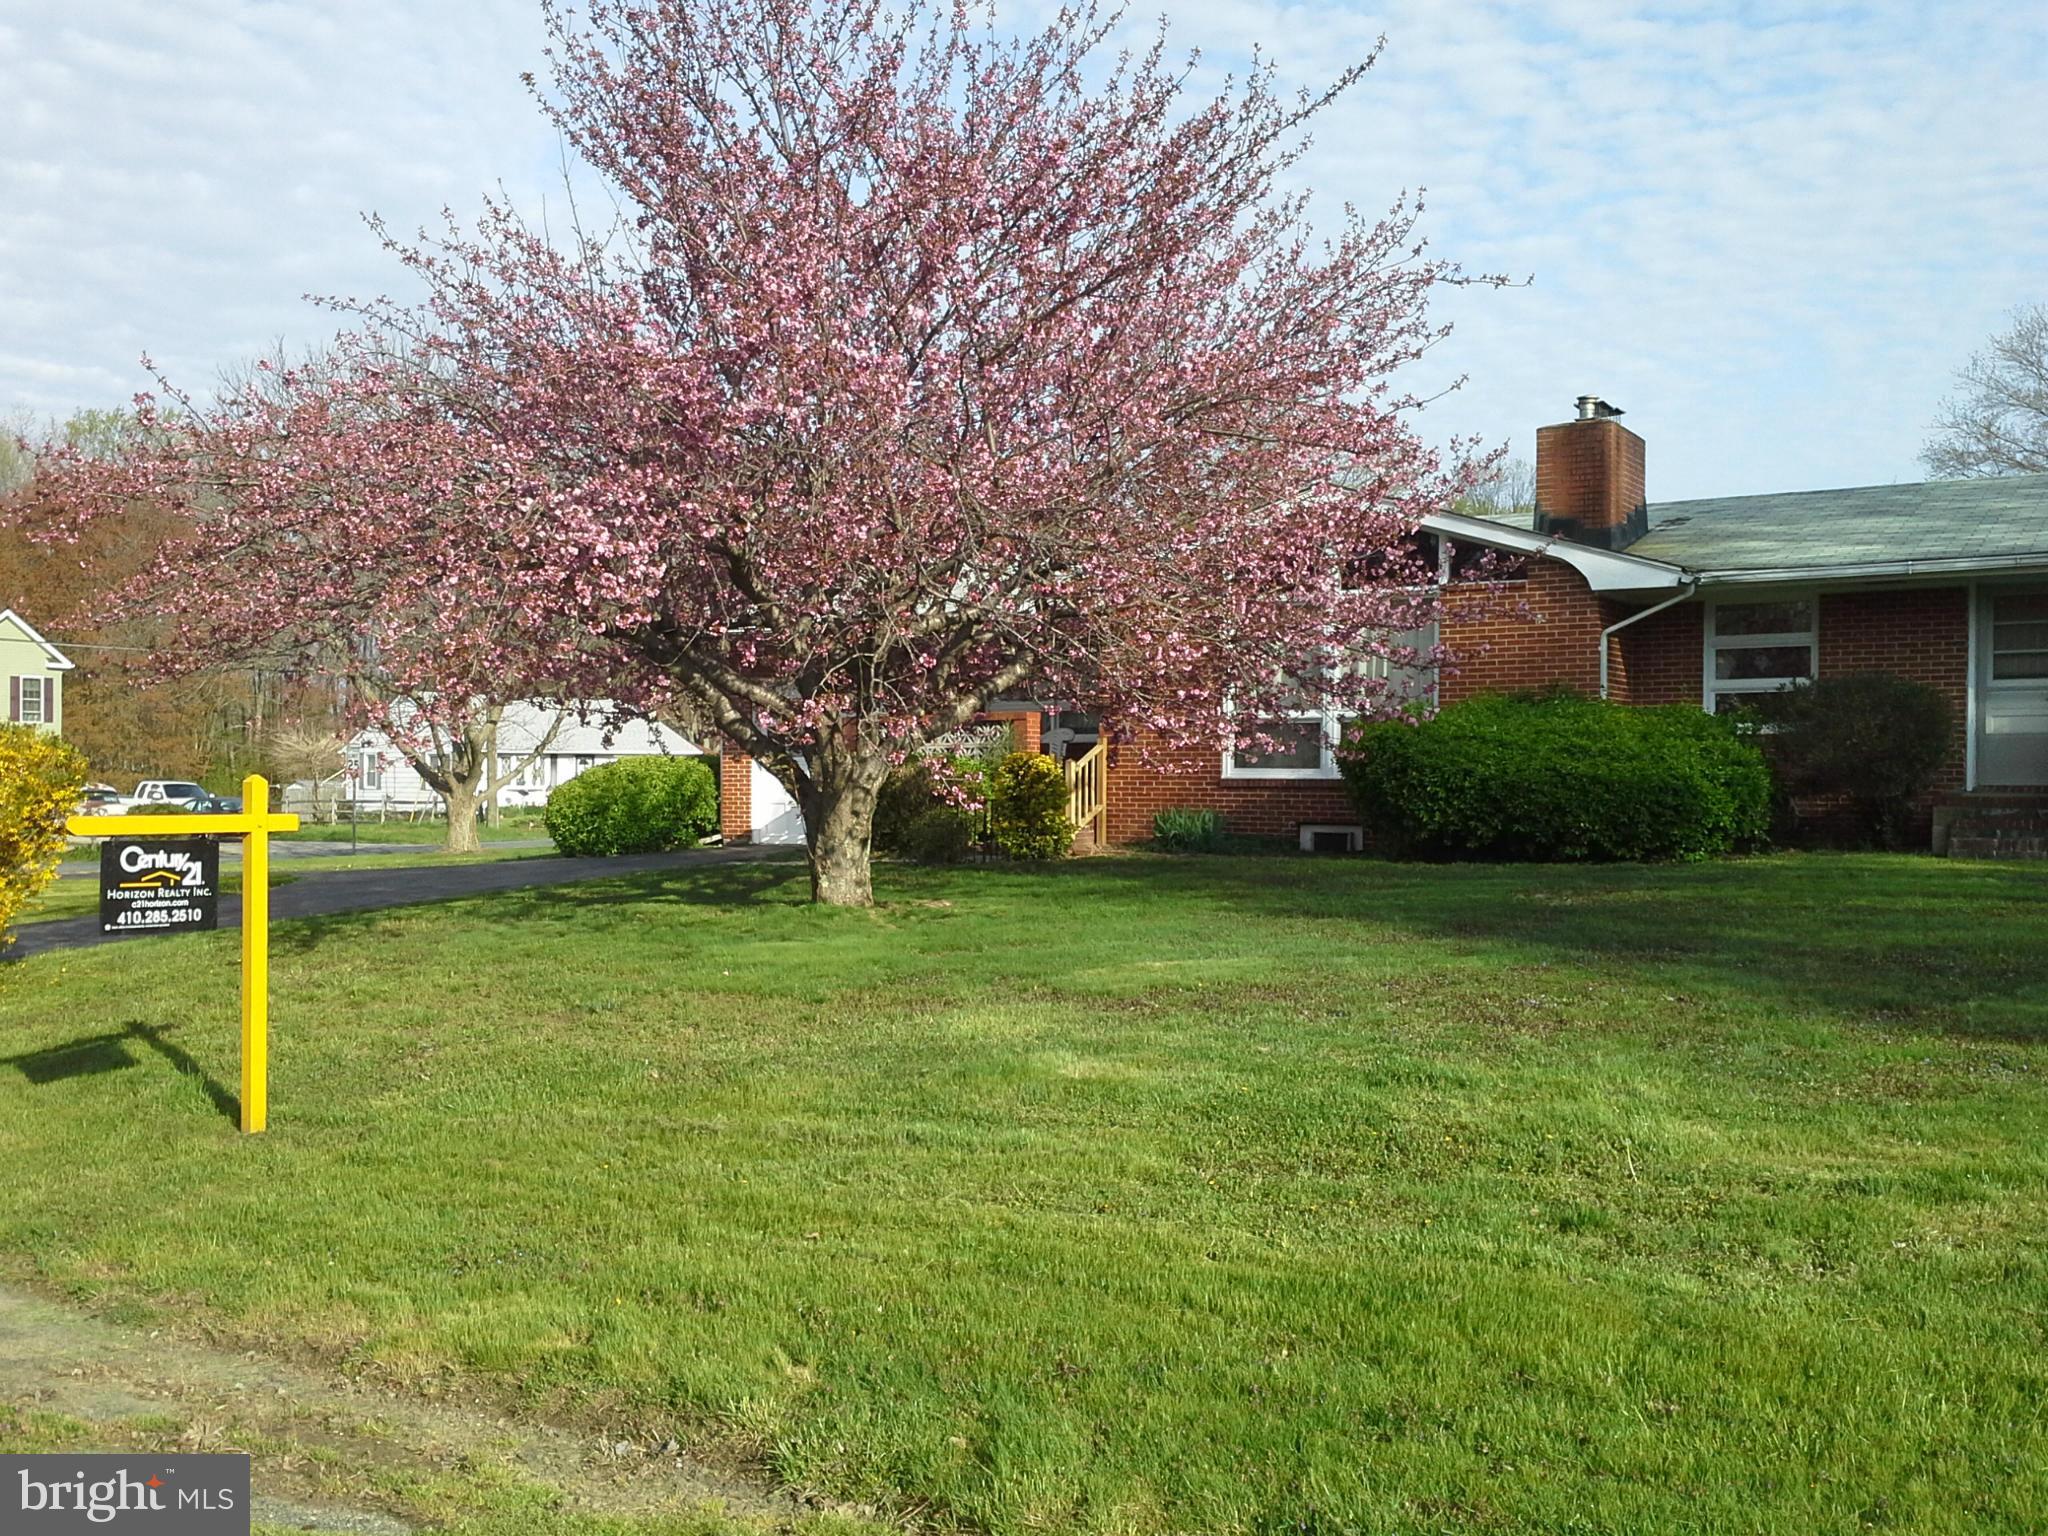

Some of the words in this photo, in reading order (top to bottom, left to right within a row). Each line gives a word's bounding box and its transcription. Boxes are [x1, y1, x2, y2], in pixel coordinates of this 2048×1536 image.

[348, 759, 360, 771] 25
[120, 845, 191, 873] Century
[107, 889, 155, 900] HORIZON
[157, 888, 191, 898] REALTY
[193, 887, 212, 897] INC.
[131, 900, 189, 909] c21horizon.com
[116, 908, 202, 925] 410.285.2510
